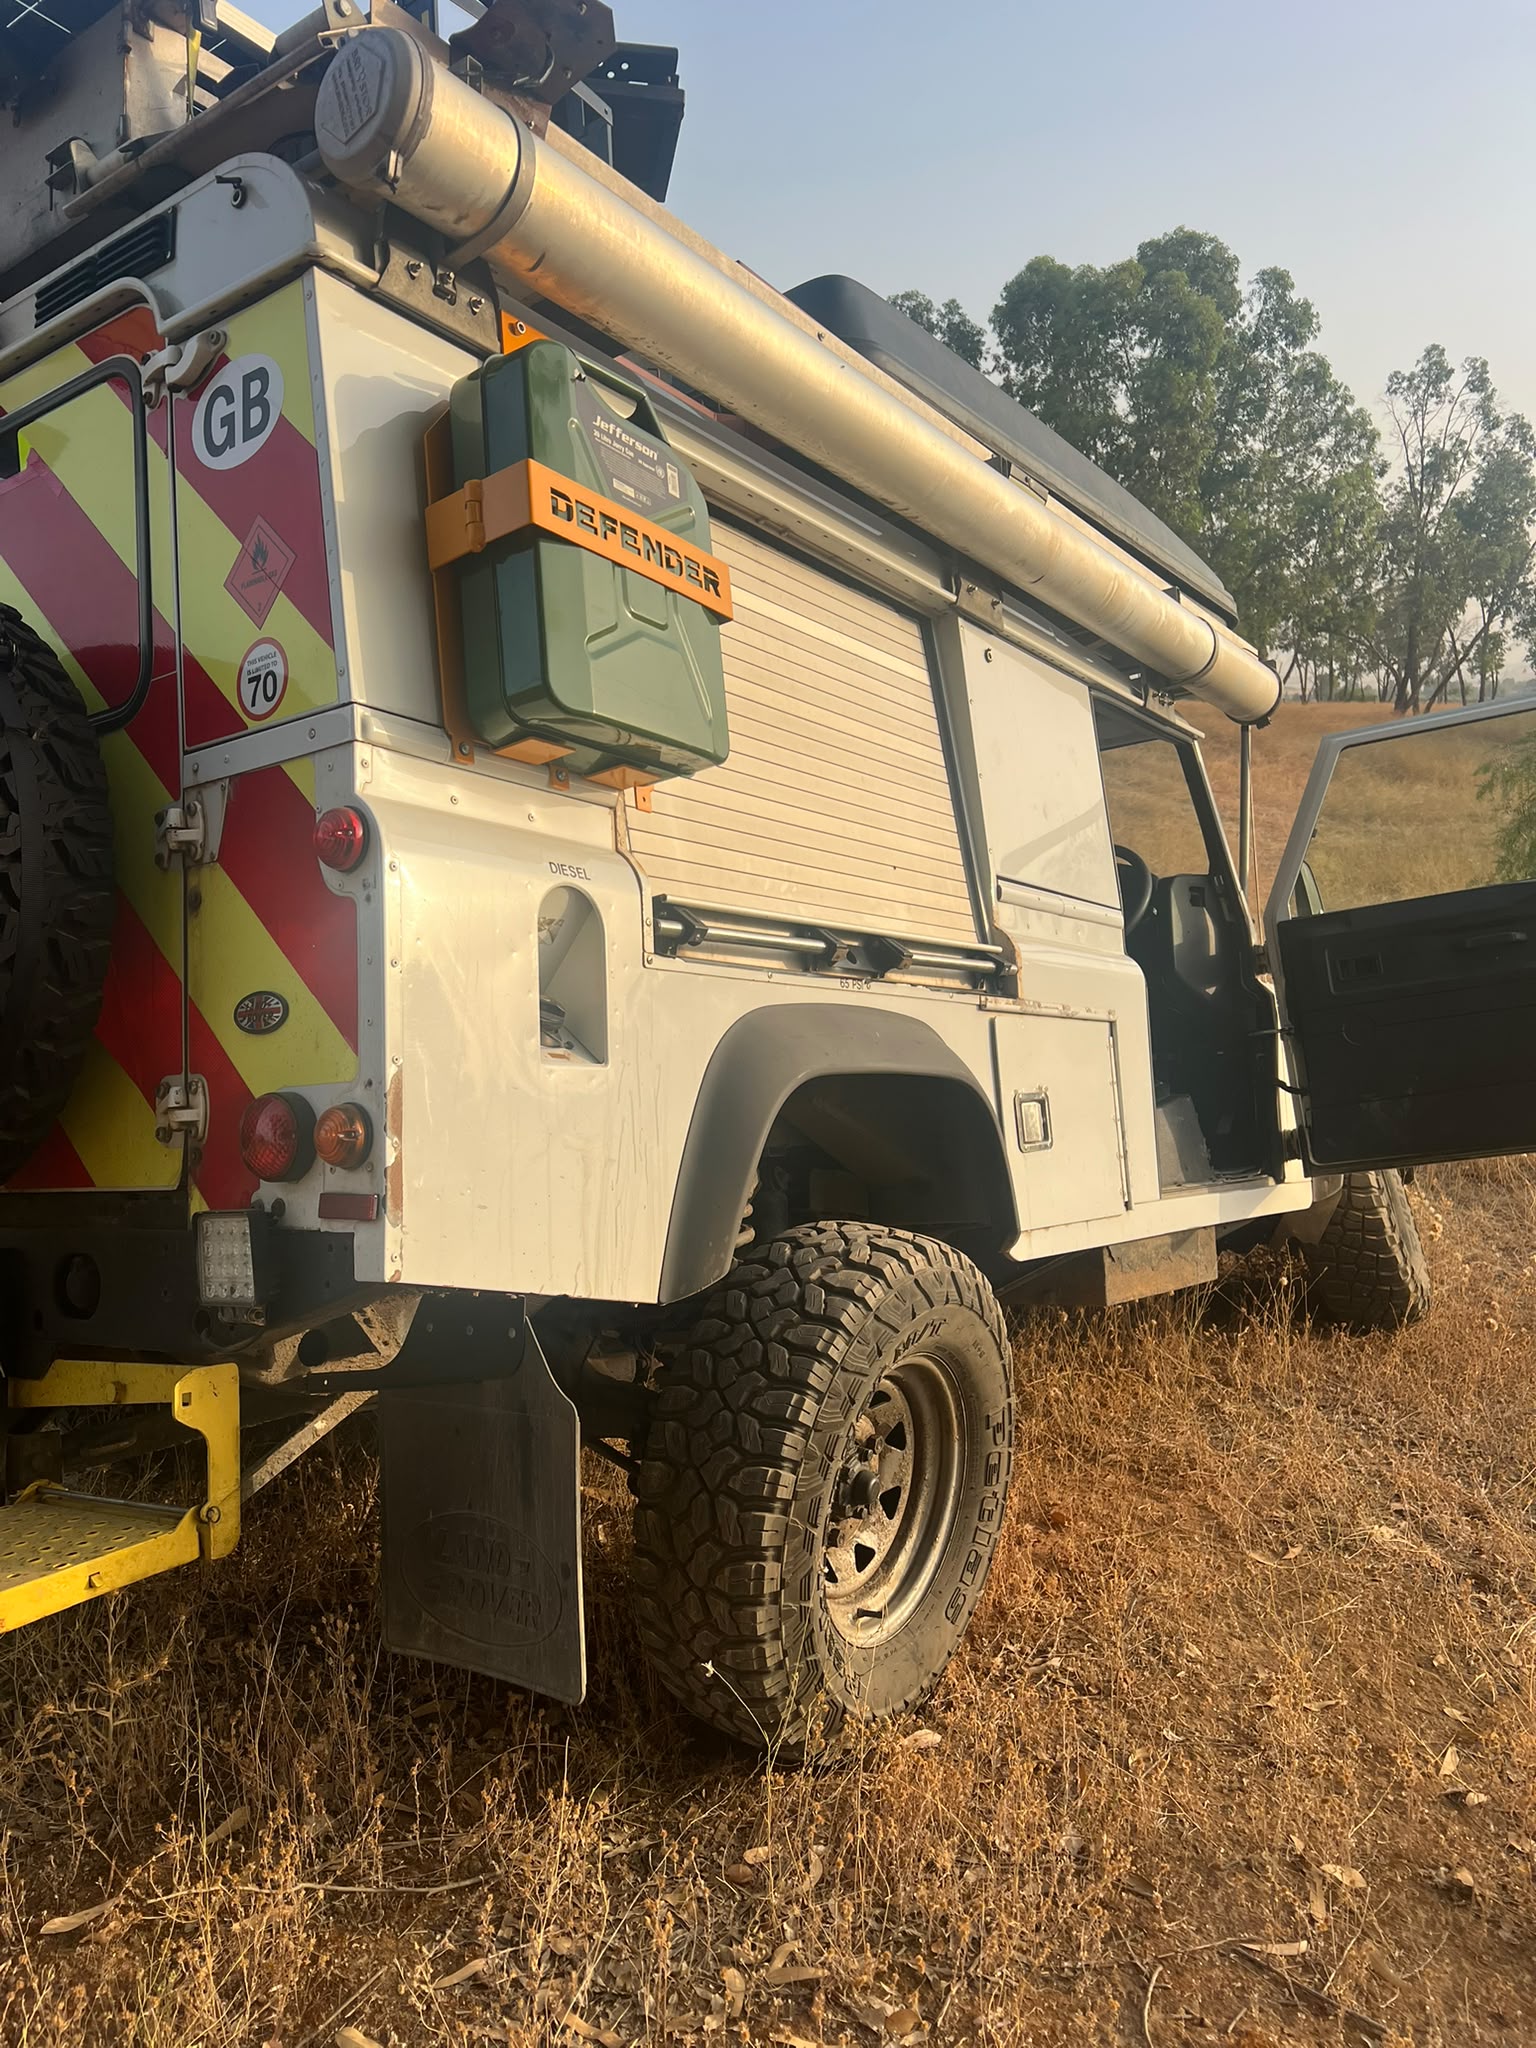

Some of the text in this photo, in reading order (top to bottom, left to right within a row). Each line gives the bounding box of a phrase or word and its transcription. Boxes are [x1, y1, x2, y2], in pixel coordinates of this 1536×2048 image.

[203, 366, 271, 458] GB
[592, 415, 658, 461] Jefferson
[550, 486, 721, 598] DEFENDER
[246, 660, 278, 677] IS LIMITED TO
[247, 651, 277, 667] THIS VEHICLE
[247, 669, 278, 708] 70
[548, 861, 591, 881] DIESEL
[944, 1406, 1006, 1626] Petlas
